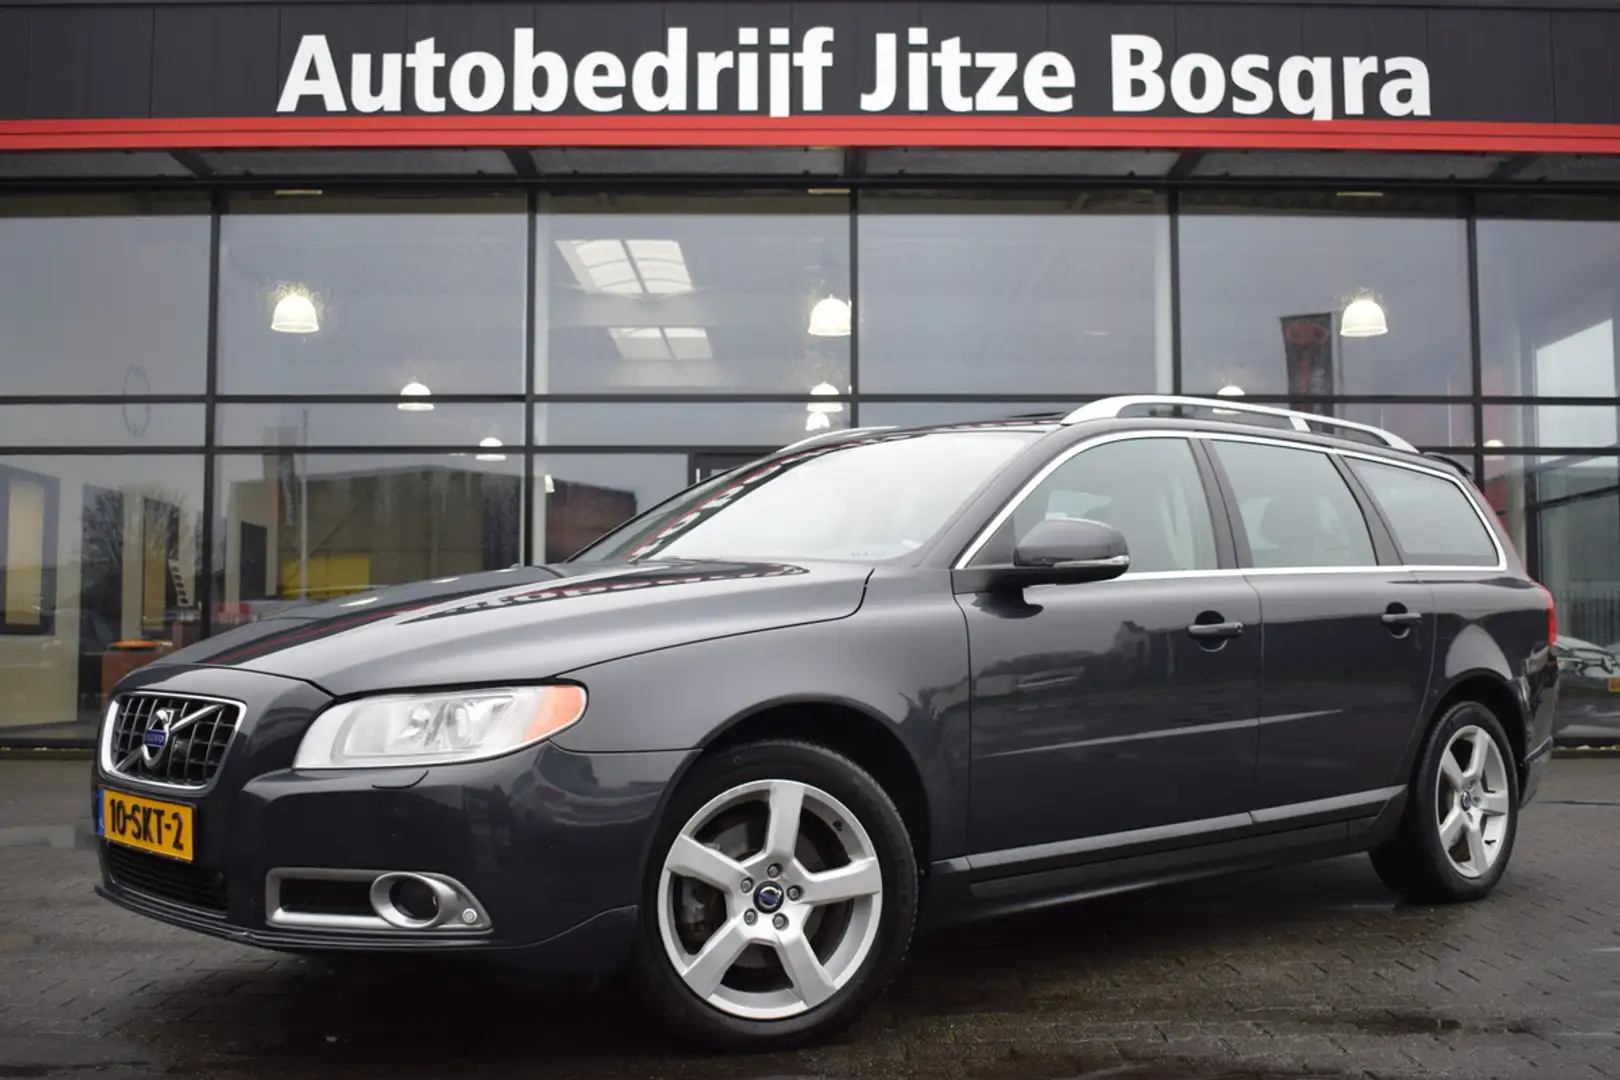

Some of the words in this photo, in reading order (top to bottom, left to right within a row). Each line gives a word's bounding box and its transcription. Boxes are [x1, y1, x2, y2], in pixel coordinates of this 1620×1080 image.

[275, 26, 835, 119] Autobedrijf
[859, 26, 1076, 113] Jitze
[110, 798, 184, 851] 10-SKT-2
